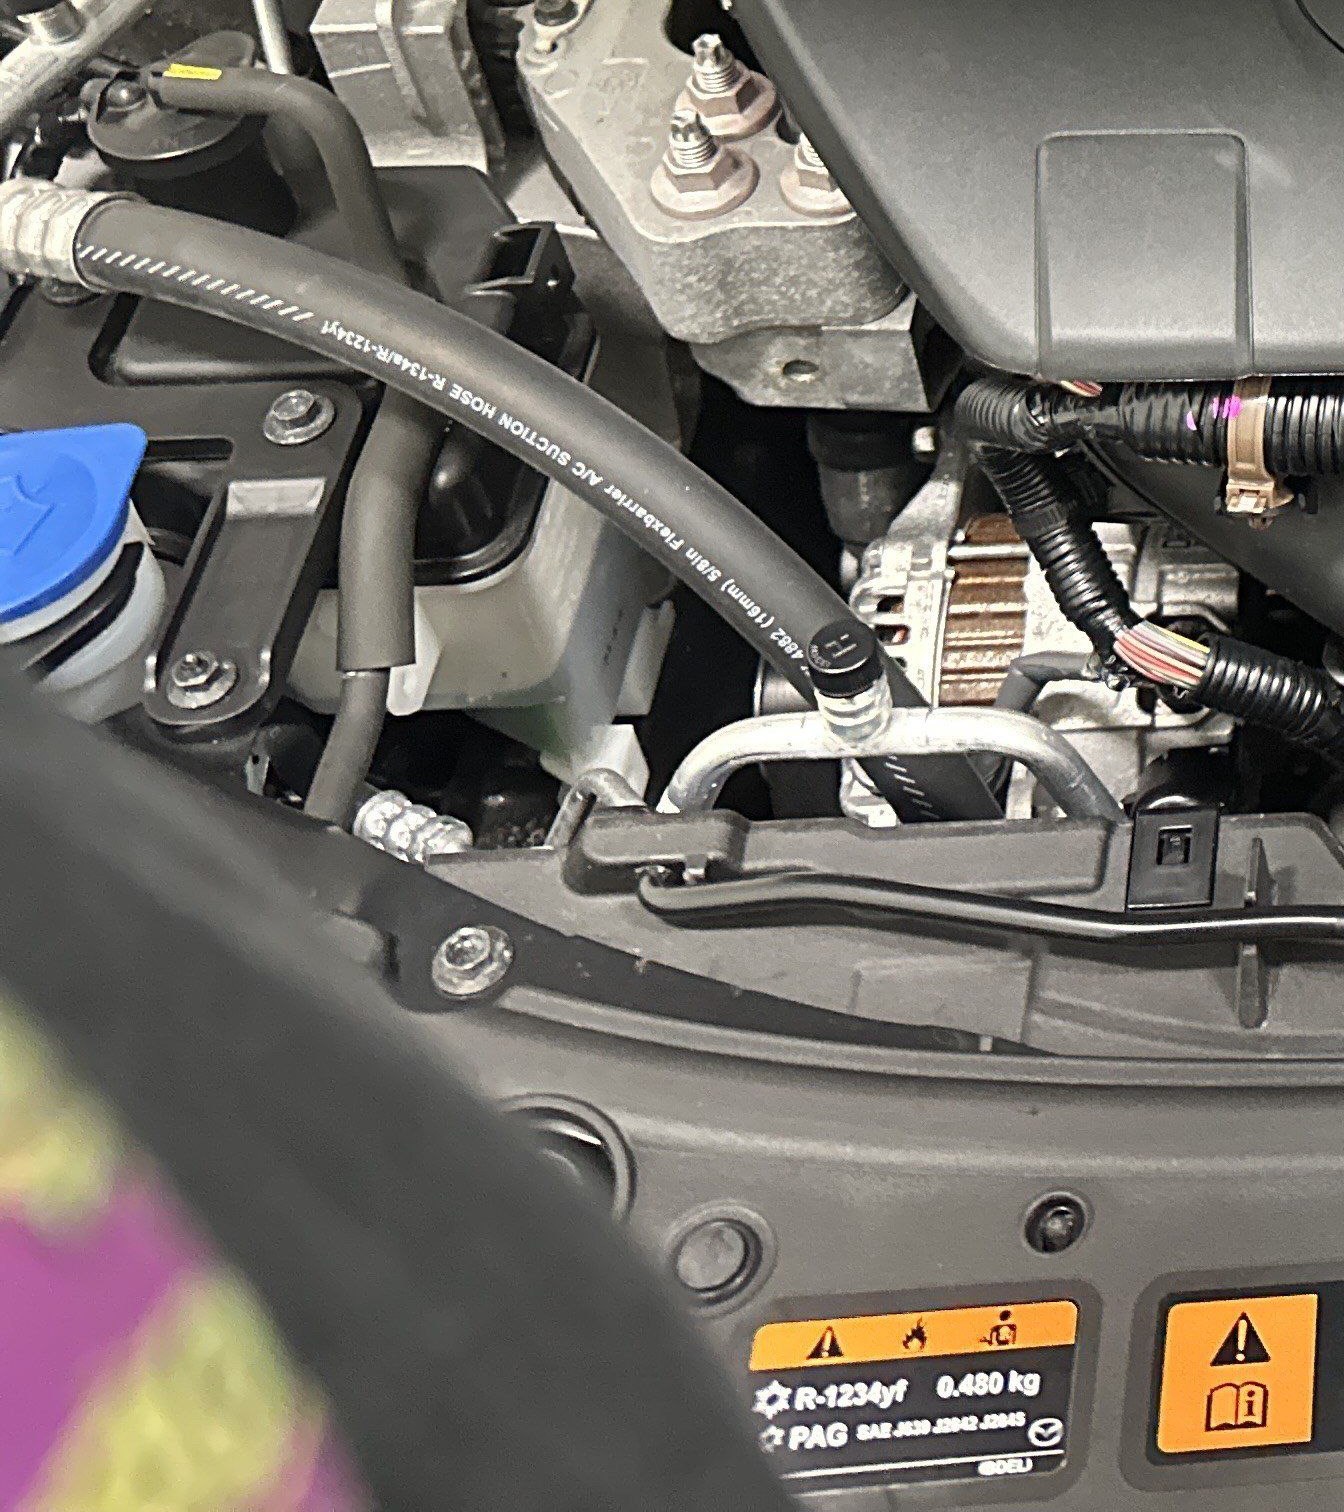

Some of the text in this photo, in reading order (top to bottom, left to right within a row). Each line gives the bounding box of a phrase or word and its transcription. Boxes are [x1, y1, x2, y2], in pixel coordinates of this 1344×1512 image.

[449, 383, 497, 419] HOSE
[498, 412, 572, 467] SUCTION
[571, 461, 603, 486] A/C
[604, 484, 685, 551] Flexbarrier
[720, 578, 775, 628] (16mm)
[769, 627, 805, 659] 4882
[794, 1369, 1041, 1411] R-1234yf 0.480 kg
[788, 1422, 849, 1451] PAG
[856, 1421, 893, 1441] SAE
